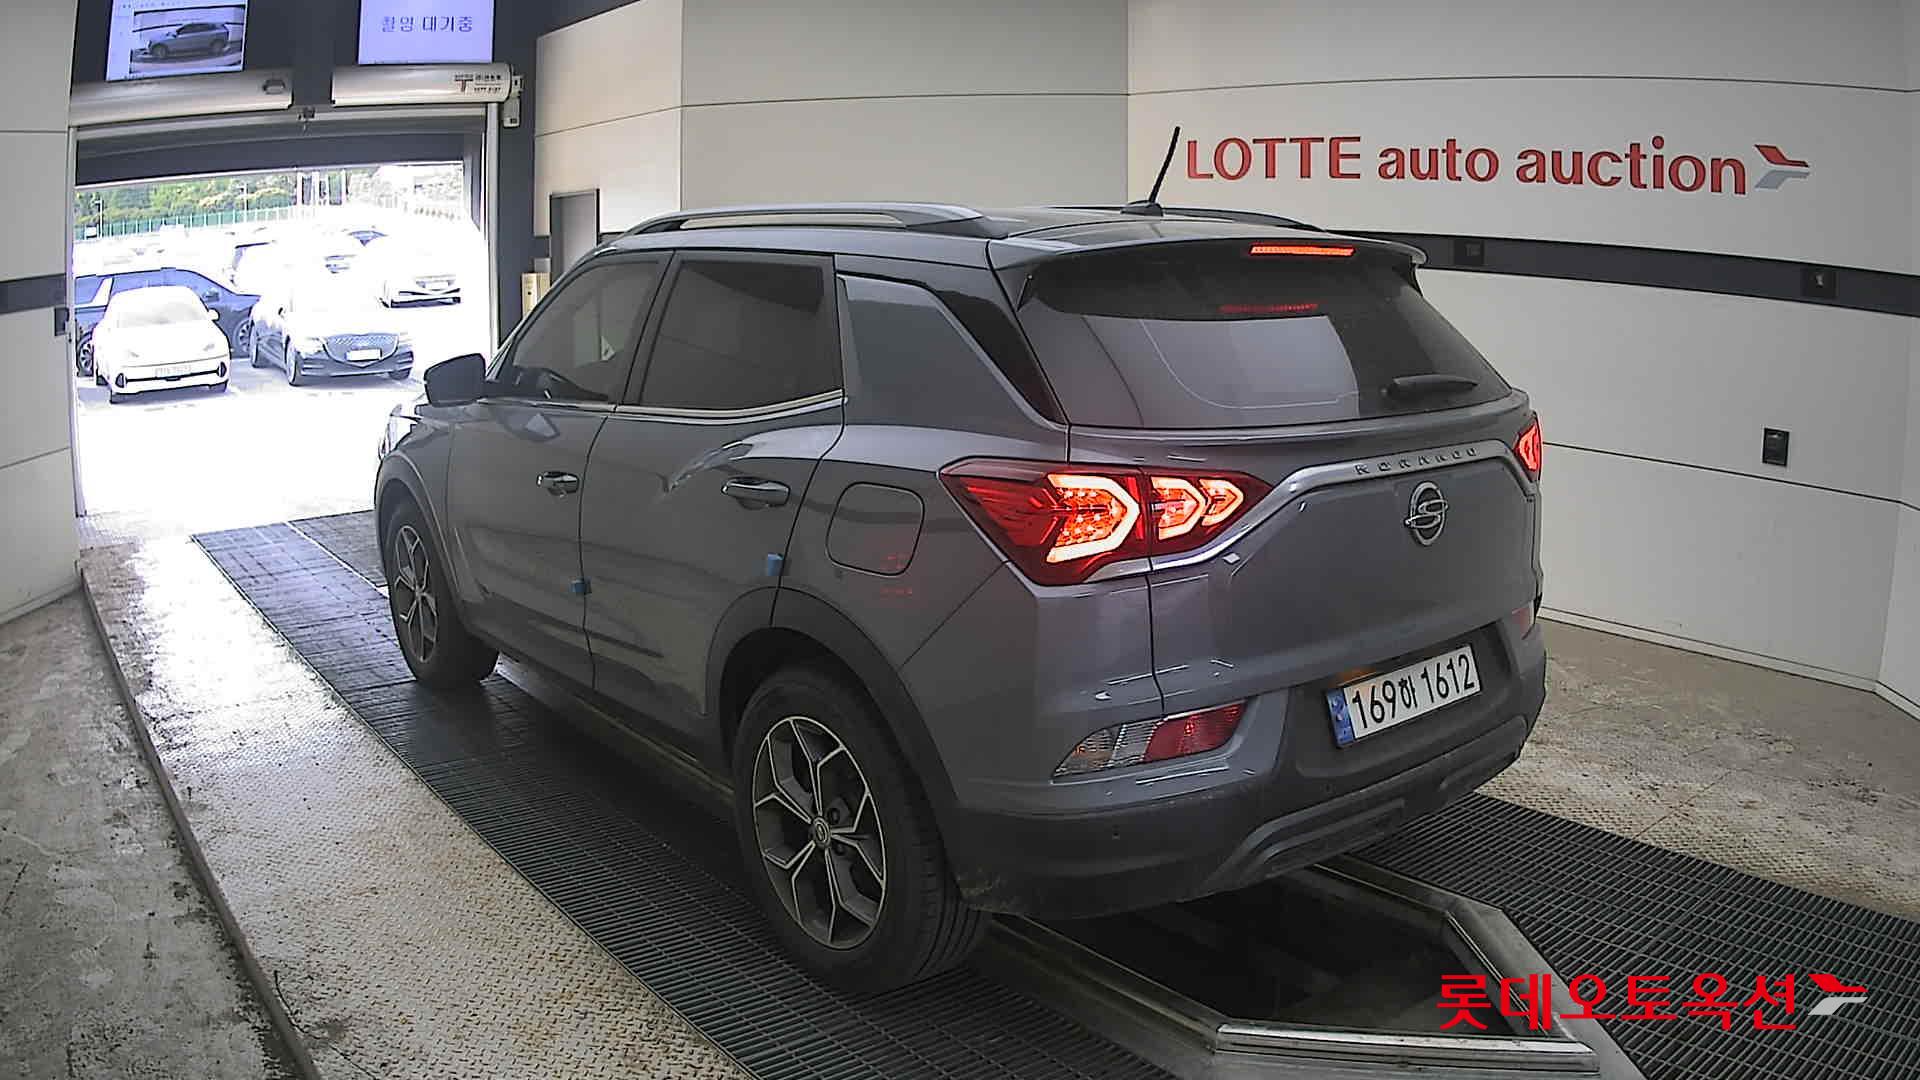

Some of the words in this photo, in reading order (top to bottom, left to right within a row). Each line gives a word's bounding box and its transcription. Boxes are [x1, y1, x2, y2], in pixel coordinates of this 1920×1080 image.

[422, 15, 473, 33] 대기중
[1187, 136, 1361, 181] LOTTE
[1377, 138, 1500, 182] auto
[1516, 136, 1747, 195] auction
[1354, 447, 1478, 476] KORANDO
[1352, 675, 1418, 729] 169하
[1421, 654, 1475, 703] 1612
